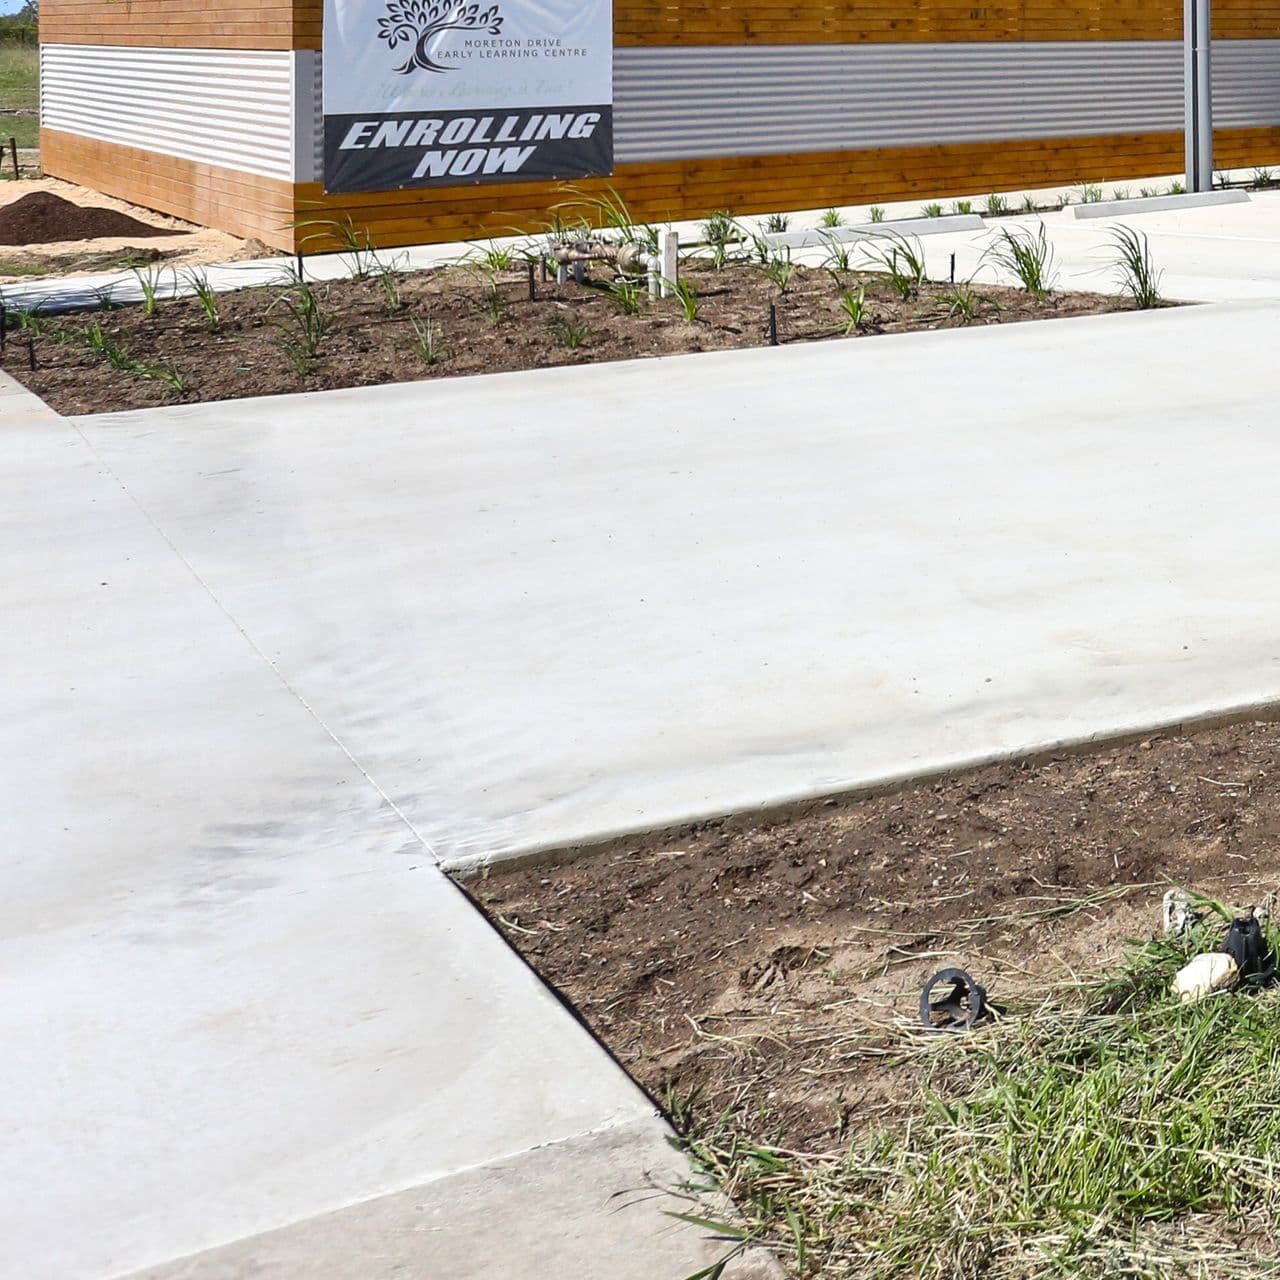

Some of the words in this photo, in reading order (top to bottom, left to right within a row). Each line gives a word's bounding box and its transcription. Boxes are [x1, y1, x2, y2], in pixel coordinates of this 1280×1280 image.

[437, 50, 473, 60] EARLY
[479, 48, 539, 59] LEARNING
[544, 48, 588, 58] CENTRE
[464, 39, 521, 49] MORETON
[527, 38, 562, 48] DRIVE
[339, 112, 602, 150] ENROLLING
[411, 145, 537, 179] NOW
